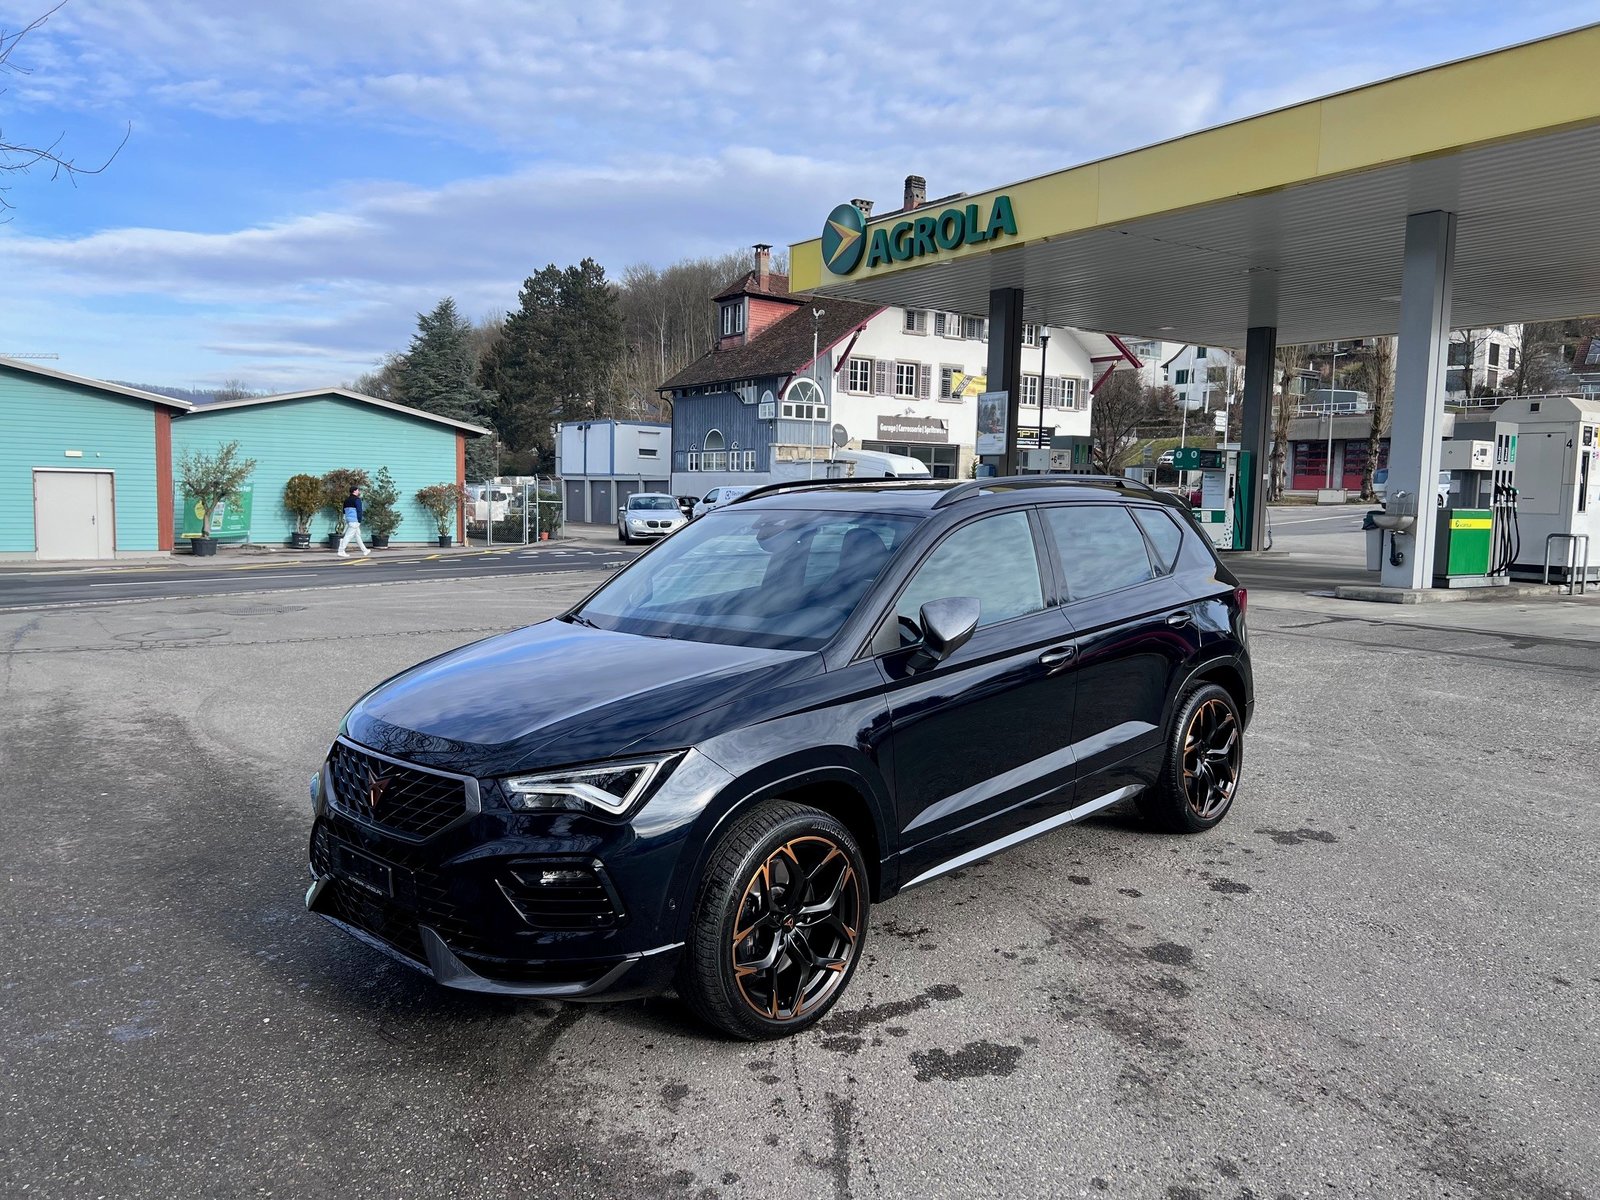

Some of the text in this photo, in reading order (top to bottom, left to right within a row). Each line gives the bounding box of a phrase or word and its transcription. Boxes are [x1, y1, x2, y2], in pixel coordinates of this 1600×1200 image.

[866, 195, 1018, 268] AGROLA
[1566, 439, 1573, 449] 4
[811, 821, 856, 854] BRIDGESTONE
